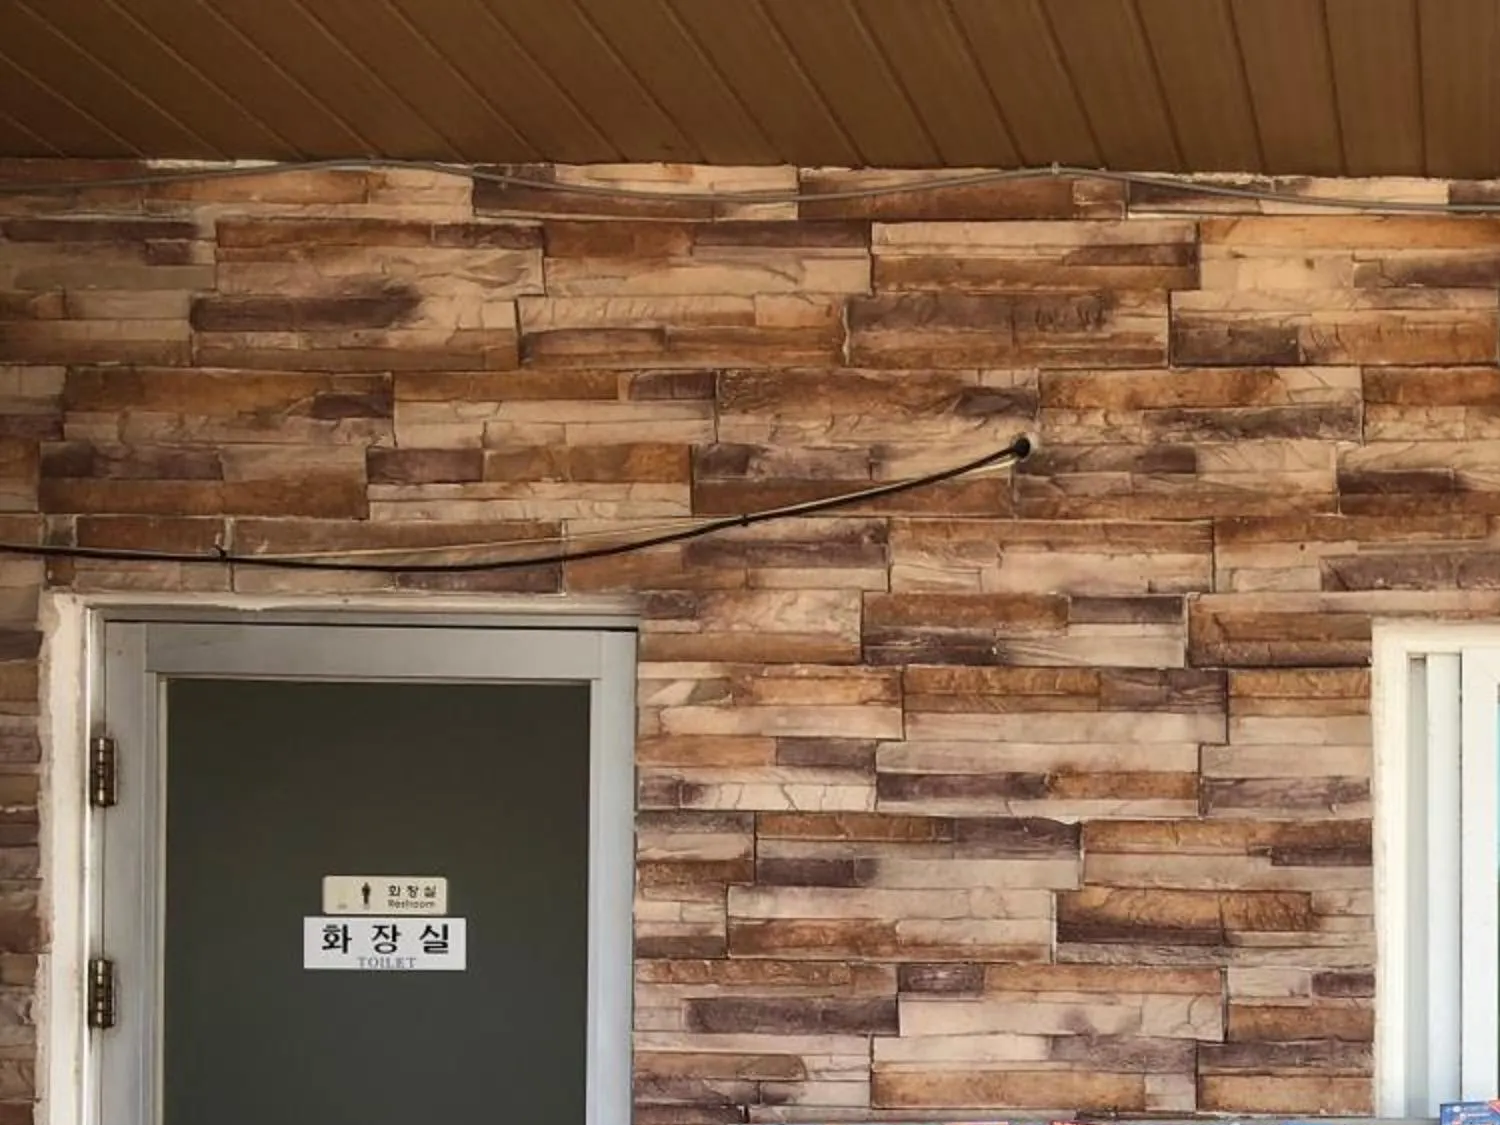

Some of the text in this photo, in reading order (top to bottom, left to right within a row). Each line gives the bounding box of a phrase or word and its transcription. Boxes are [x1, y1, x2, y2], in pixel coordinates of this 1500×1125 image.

[387, 885, 436, 898] 화장실
[321, 923, 449, 955] 화장실
[357, 956, 417, 970] TOILET
